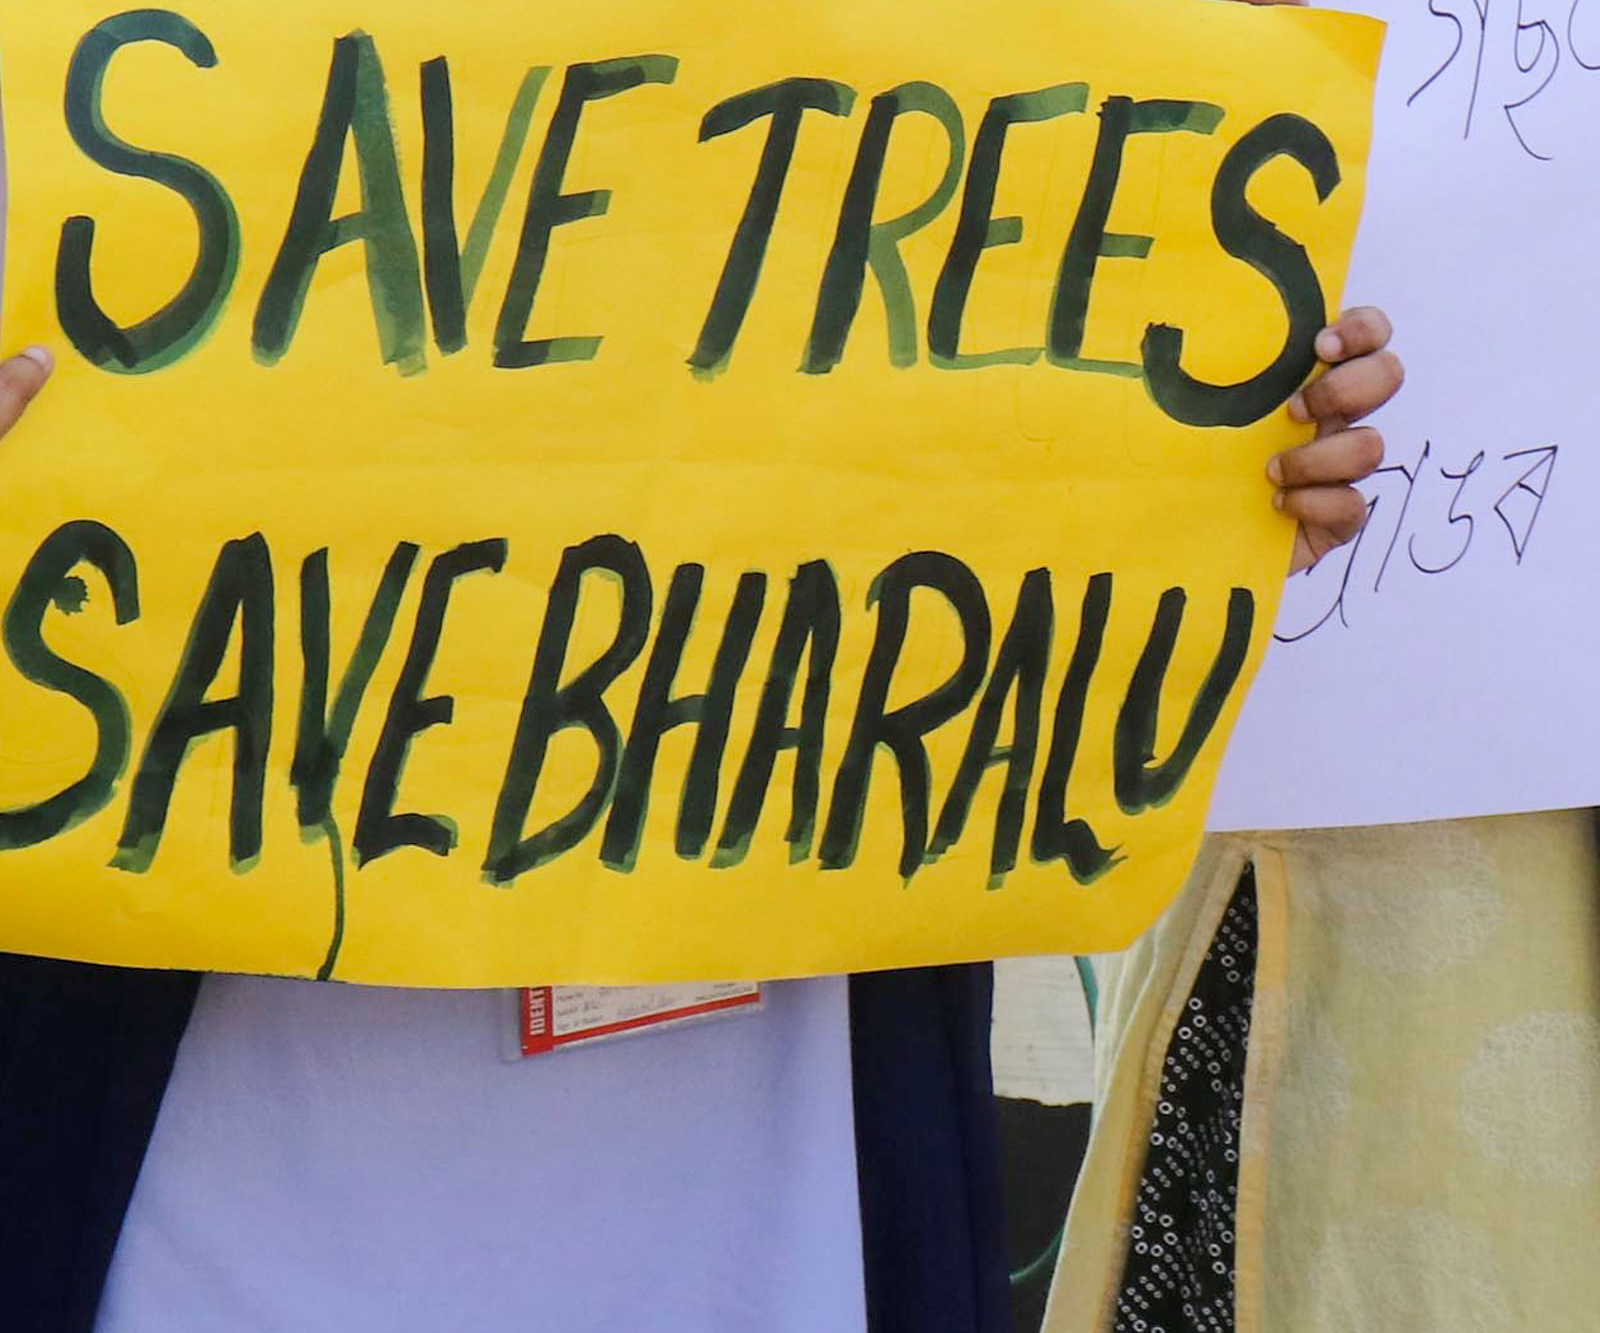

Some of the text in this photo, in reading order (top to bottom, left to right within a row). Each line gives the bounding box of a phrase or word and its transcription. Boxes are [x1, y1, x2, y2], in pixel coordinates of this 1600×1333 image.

[54, 8, 1343, 430] SAVE TREES
[481, 532, 1253, 890] BHARALU
